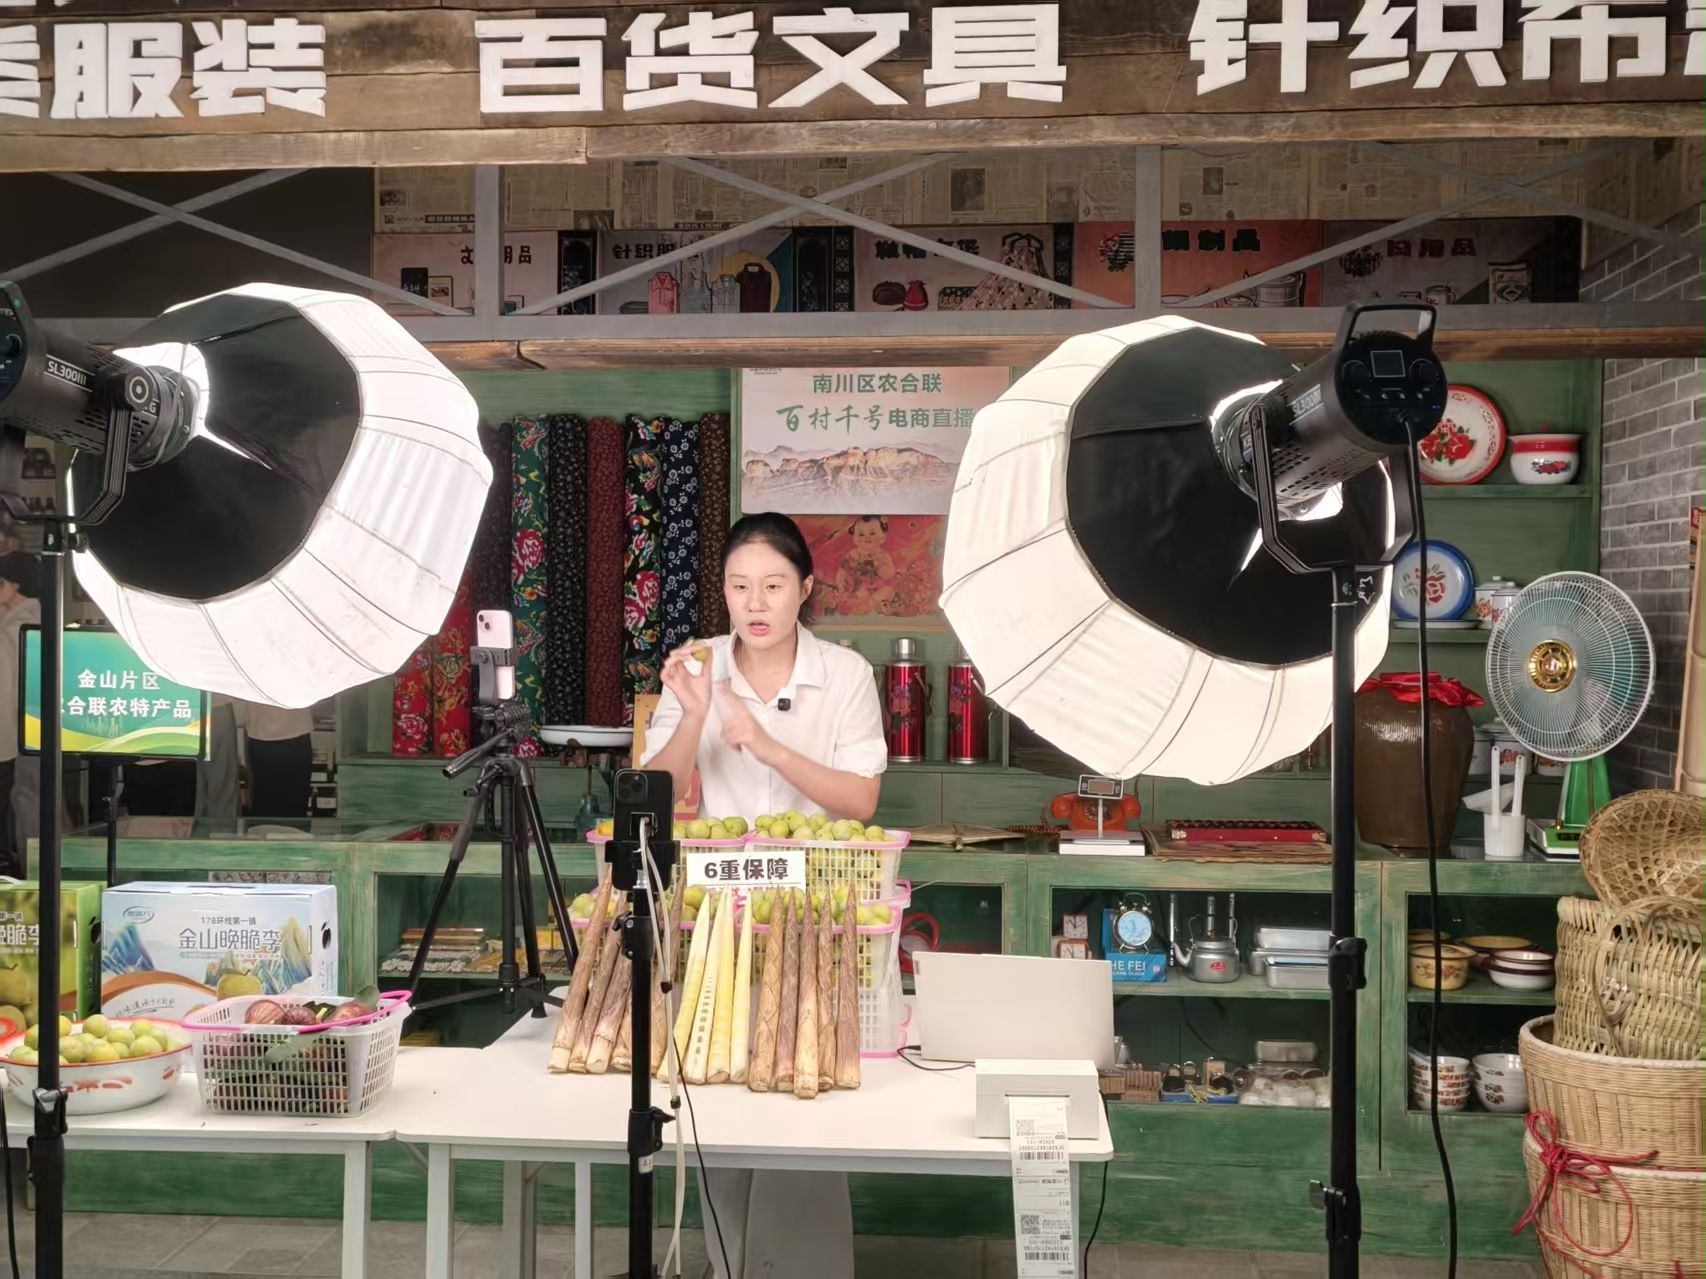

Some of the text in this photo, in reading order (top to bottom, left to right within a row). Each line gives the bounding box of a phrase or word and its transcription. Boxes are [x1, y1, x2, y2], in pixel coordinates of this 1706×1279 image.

[474, 3, 1067, 113] 百货文具
[1187, 0, 1706, 95] 针织布
[460, 245, 532, 265] 文用品
[813, 373, 942, 393] 南川区农合联
[776, 403, 975, 435] 百村千号电商直播
[78, 669, 161, 690] 金山片区
[61, 696, 192, 718] 合联农特产品
[704, 858, 789, 881] 6重保障
[178, 928, 281, 952] 金山晚脆李
